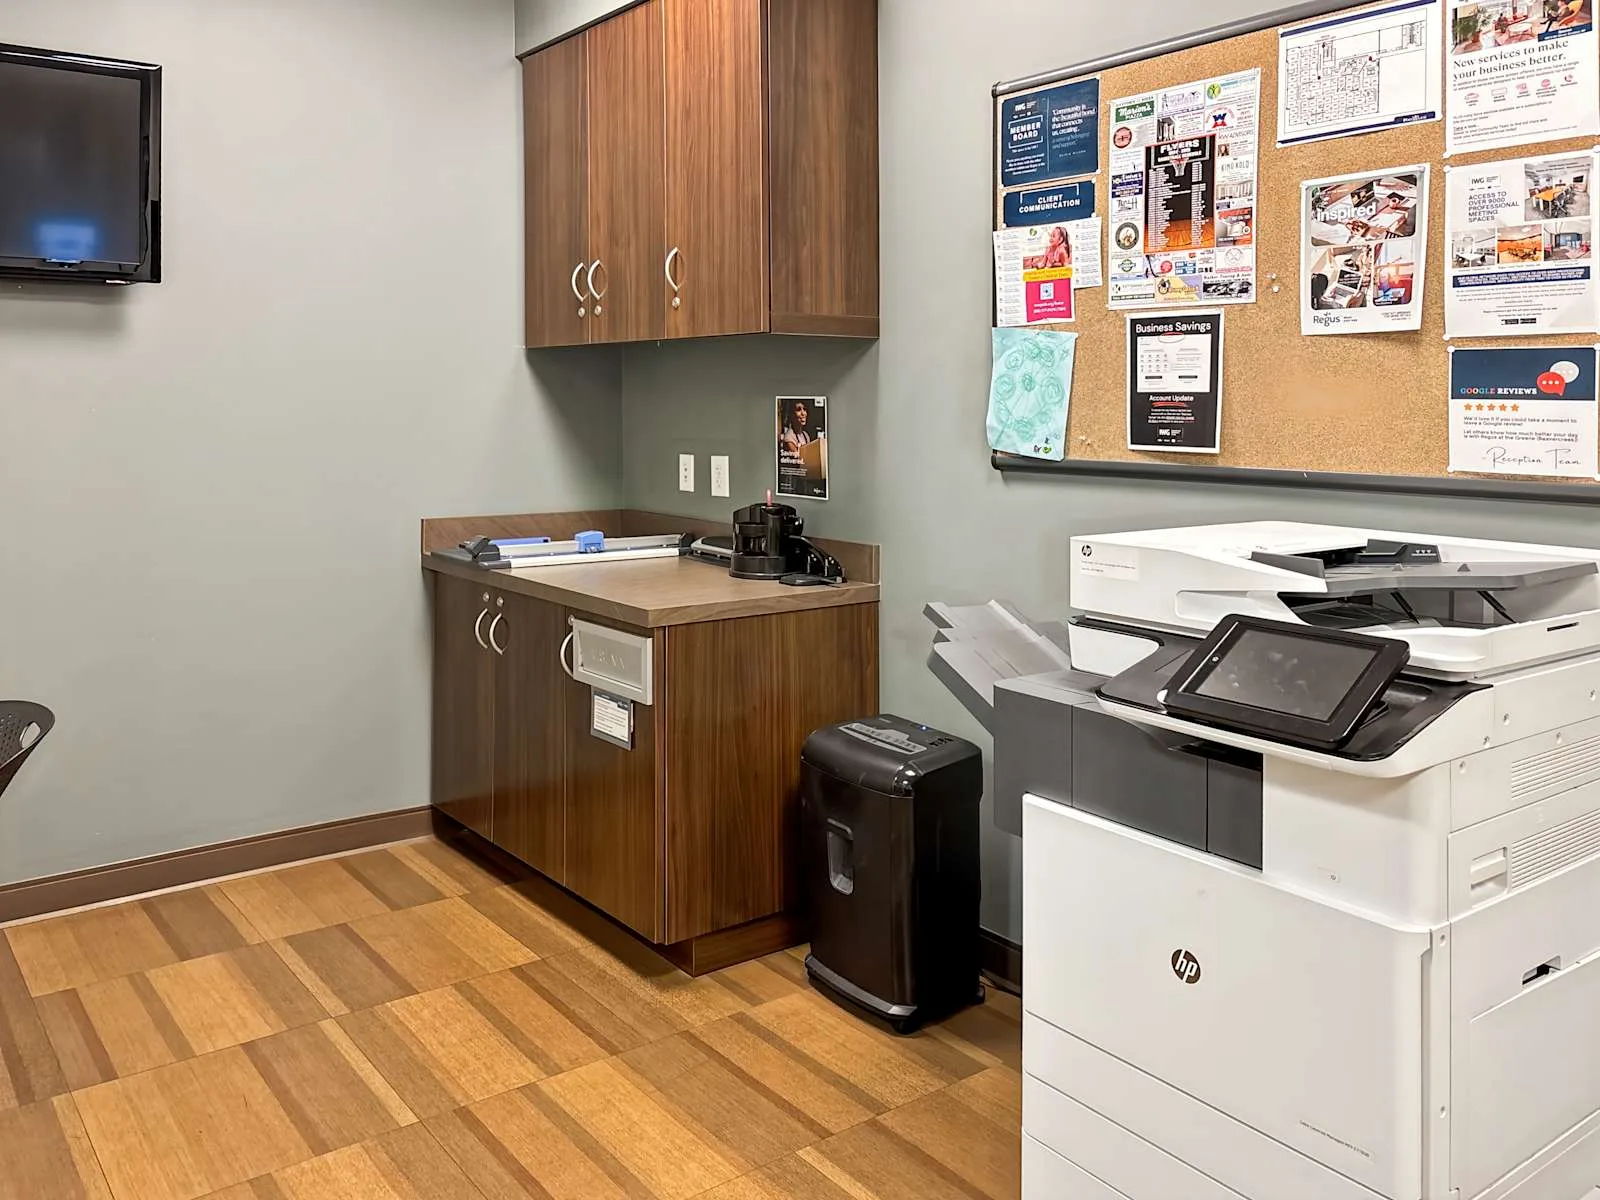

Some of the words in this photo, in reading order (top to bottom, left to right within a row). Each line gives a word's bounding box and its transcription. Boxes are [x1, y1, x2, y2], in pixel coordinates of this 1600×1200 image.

[1453, 60, 1475, 69] New
[1478, 50, 1521, 64] services
[1523, 47, 1535, 56] to
[1538, 40, 1569, 52] make
[1453, 70, 1477, 82] your
[1479, 61, 1527, 75] business
[1529, 54, 1567, 66] better.
[1010, 122, 1041, 134] MEMBER
[1013, 130, 1038, 141] BOARD
[1160, 139, 1200, 154] FLYERS
[1038, 194, 1063, 204] CLIENT
[1019, 199, 1080, 213] COMMUNICATION
[1469, 201, 1520, 211] PROFESSIONAL
[1317, 203, 1376, 222] inspired
[1469, 215, 1495, 223] SPACES
[1136, 323, 1173, 333] Business
[1175, 321, 1212, 333] Savings
[1313, 315, 1341, 327] Regus
[1172, 394, 1194, 402] Update
[1486, 446, 1542, 468] Reception
[1545, 448, 1581, 469] Team
[1172, 949, 1200, 984] hp
